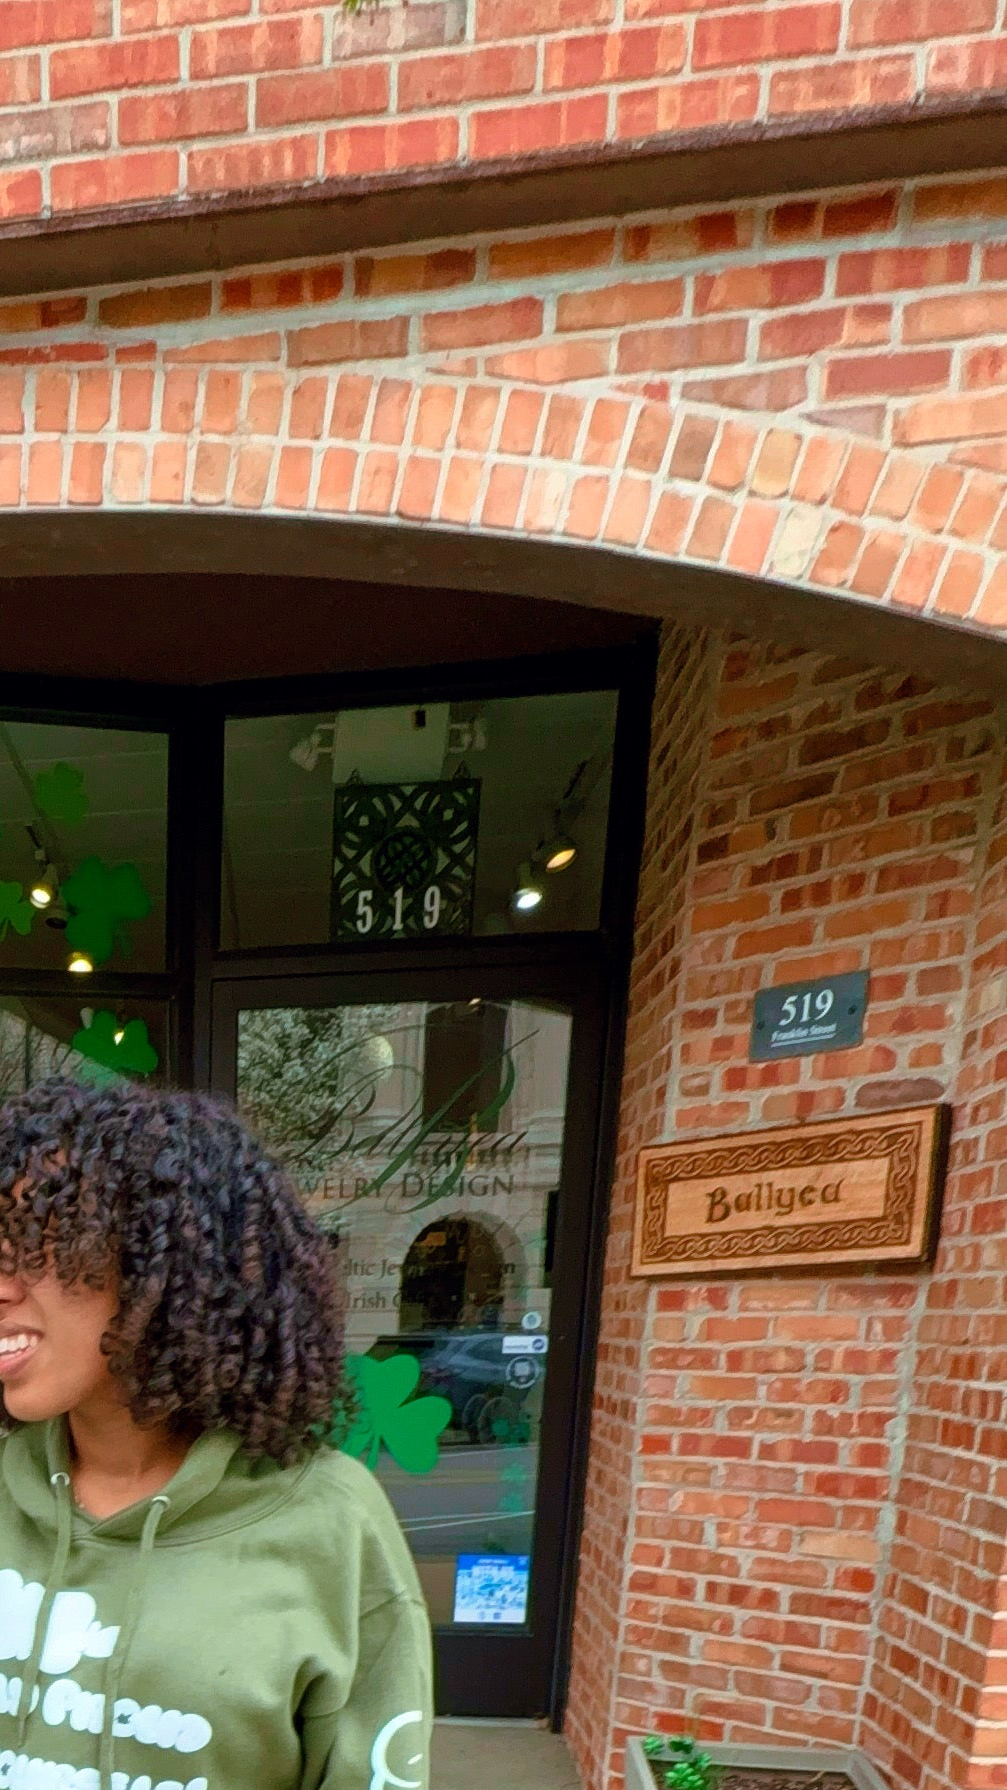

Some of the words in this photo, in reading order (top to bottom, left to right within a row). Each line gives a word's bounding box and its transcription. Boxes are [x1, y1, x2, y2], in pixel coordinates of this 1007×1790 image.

[355, 885, 441, 934] 519
[778, 988, 834, 1026] 519
[296, 1175, 383, 1200] WELRY
[704, 1177, 845, 1223] Ballyea
